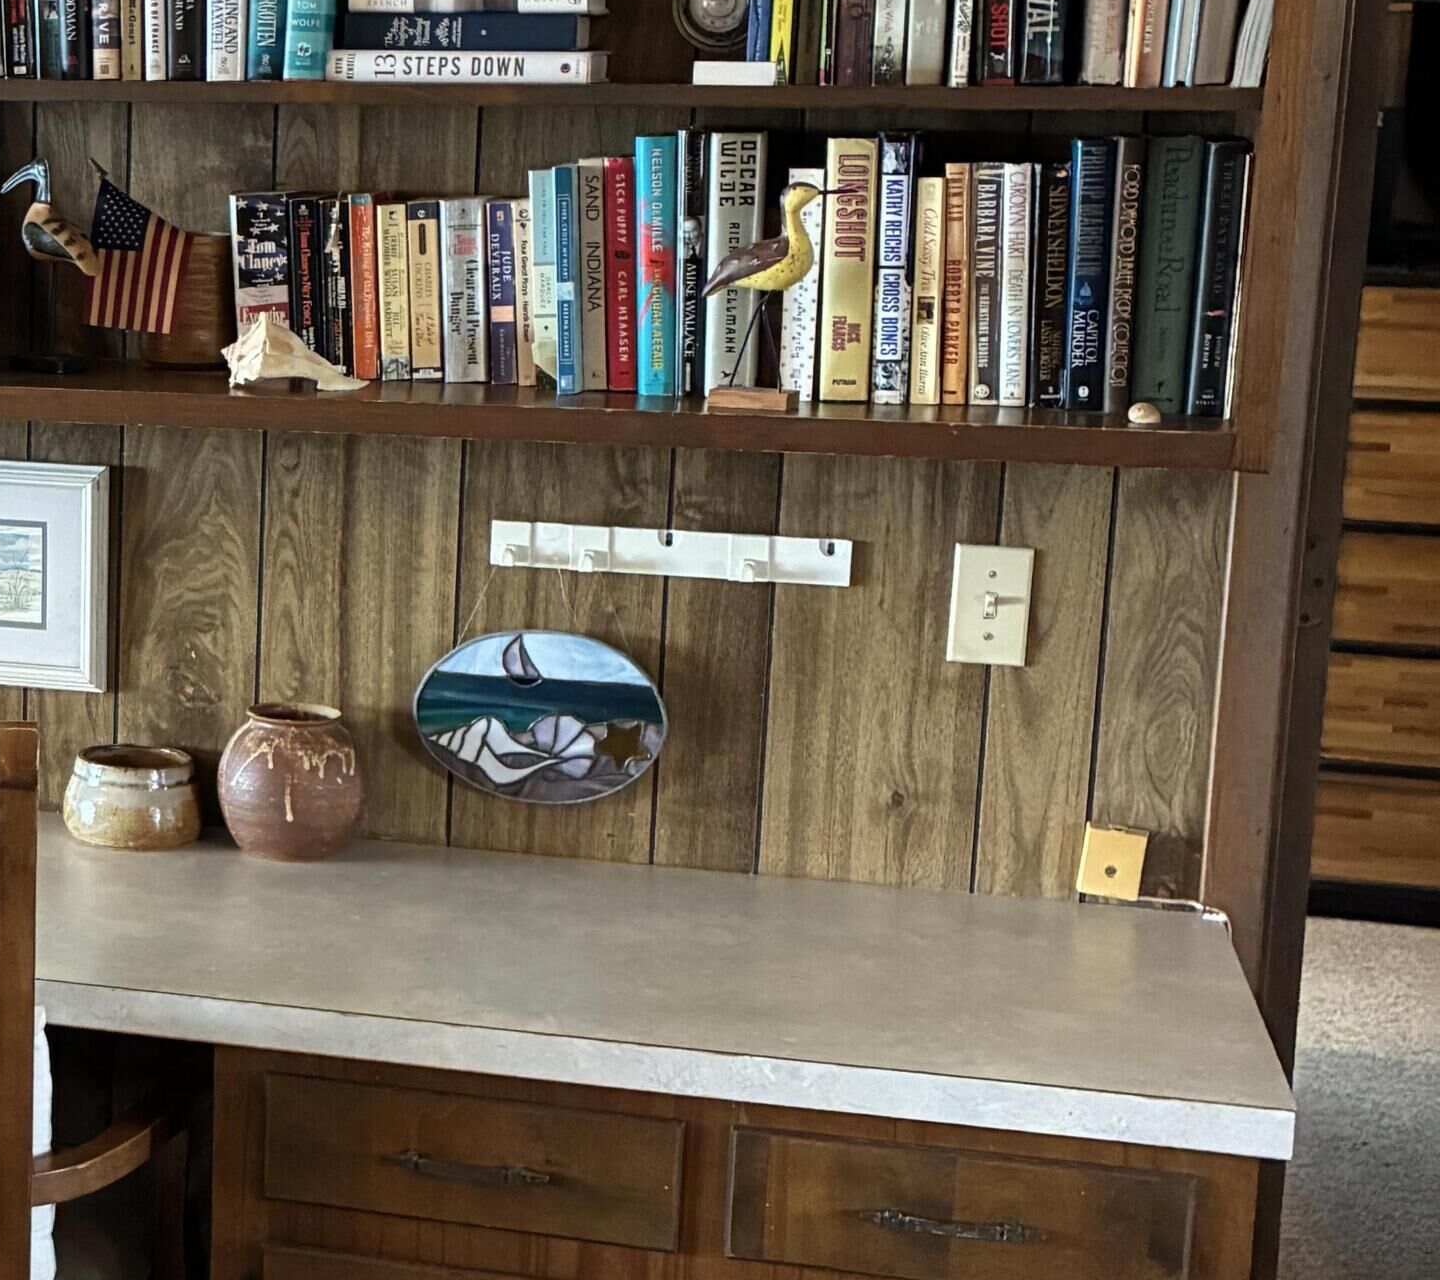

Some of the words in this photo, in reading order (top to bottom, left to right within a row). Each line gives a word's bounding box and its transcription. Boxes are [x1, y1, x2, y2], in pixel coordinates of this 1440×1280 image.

[291, 17, 321, 27] WOLFE
[297, 1, 317, 9] TOM
[225, 24, 238, 54] AND
[990, 4, 1008, 48] SHOT
[374, 53, 397, 79] 13
[403, 56, 461, 76] STEPS
[471, 56, 526, 76] DOWN
[615, 174, 625, 204] SICK
[652, 148, 662, 196] NELSON
[719, 140, 736, 207] WILDE
[739, 141, 756, 207] OSCAR
[585, 175, 600, 221] SAND
[834, 154, 870, 262] LONGSHOT
[886, 179, 905, 217] KATHY
[947, 204, 963, 222] AIR
[976, 183, 997, 242] BARBARA
[1008, 171, 1027, 226] CAROLYN
[1047, 184, 1067, 237] SIDNEY
[616, 209, 626, 243] PUPPY
[883, 220, 904, 262] REICHS
[922, 208, 939, 236] Cold
[245, 239, 276, 254] Tom
[521, 256, 529, 273] Great
[976, 246, 996, 278] VINE
[1008, 232, 1025, 262] HART
[391, 268, 399, 297] SUSAN
[465, 259, 478, 291] Clear
[491, 233, 501, 300] DEVERAUX
[501, 251, 511, 282] JUDE
[520, 274, 528, 296] Plays
[586, 241, 601, 313] INDIANA
[618, 271, 627, 301] CARL
[685, 263, 697, 297] MIKE
[945, 259, 961, 305] ROBERT
[1009, 269, 1024, 302] DEATH
[1045, 239, 1065, 309] SHELDON
[466, 292, 479, 316] and
[882, 273, 901, 313] CROSS
[1008, 305, 1023, 317] IN
[449, 292, 465, 335] Danger
[683, 301, 696, 357] WALLACE
[725, 289, 739, 354] ELLMANN
[467, 320, 479, 365] Present
[618, 307, 629, 362] HIAASEN
[652, 330, 664, 370] AFFAIR
[847, 323, 861, 344] DICK
[880, 317, 900, 356] BONES
[944, 320, 960, 365] PARKER
[1071, 309, 1086, 368] MURDER
[1087, 309, 1099, 367] CAPITOL
[1006, 362, 1020, 389] LANE
